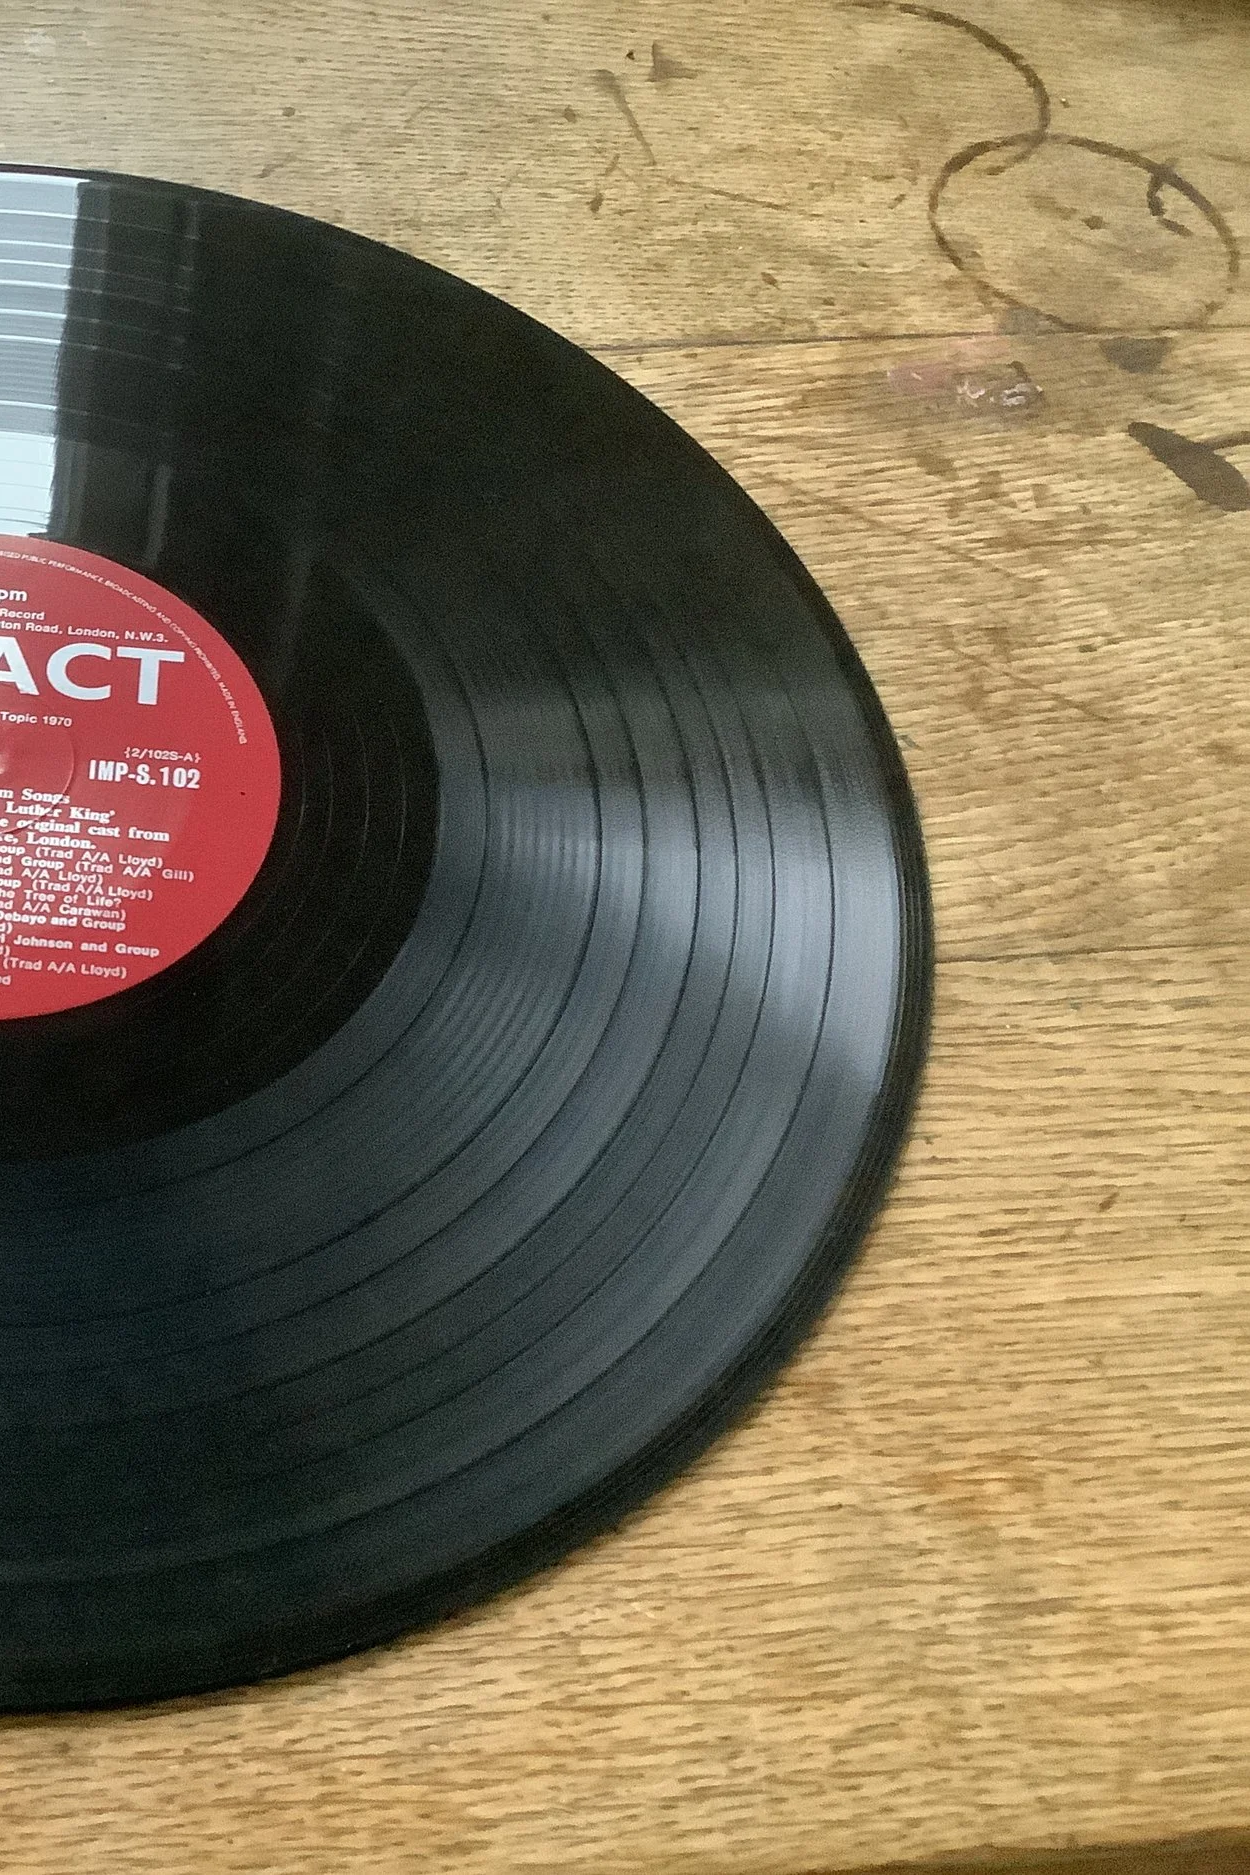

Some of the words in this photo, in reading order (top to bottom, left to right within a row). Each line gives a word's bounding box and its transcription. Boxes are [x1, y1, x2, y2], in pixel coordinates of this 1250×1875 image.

[0, 608, 45, 620] Record
[68, 626, 120, 640] London,
[0, 711, 38, 725] Topic
[42, 715, 73, 727] 1970
[21, 788, 70, 805] Songs
[88, 824, 120, 838] cast
[128, 827, 170, 842] from
[35, 845, 73, 859] (Trad
[81, 850, 111, 863] A/A
[118, 853, 163, 869] Lloyd)
[21, 856, 65, 871] Group
[75, 860, 114, 874] (Trad
[123, 865, 152, 878] A/A
[161, 868, 195, 883] Gill)
[21, 867, 51, 880] A/A
[58, 870, 104, 885] Lloyd)
[23, 889, 56, 902] Tree
[63, 893, 79, 904] of
[86, 894, 122, 908] Life?
[32, 879, 71, 893] (Trad
[75, 883, 104, 896] A/A
[108, 886, 154, 901] Lloyd)
[22, 901, 51, 914] A/A
[58, 903, 127, 921] Carawan)
[50, 915, 77, 927] and
[81, 917, 126, 932] Group
[13, 934, 73, 950] Johnson
[80, 941, 108, 953] and
[114, 943, 160, 958] Group
[2, 957, 43, 971] (Trad
[47, 961, 77, 974] A/A
[80, 964, 127, 979] Lloyd)
